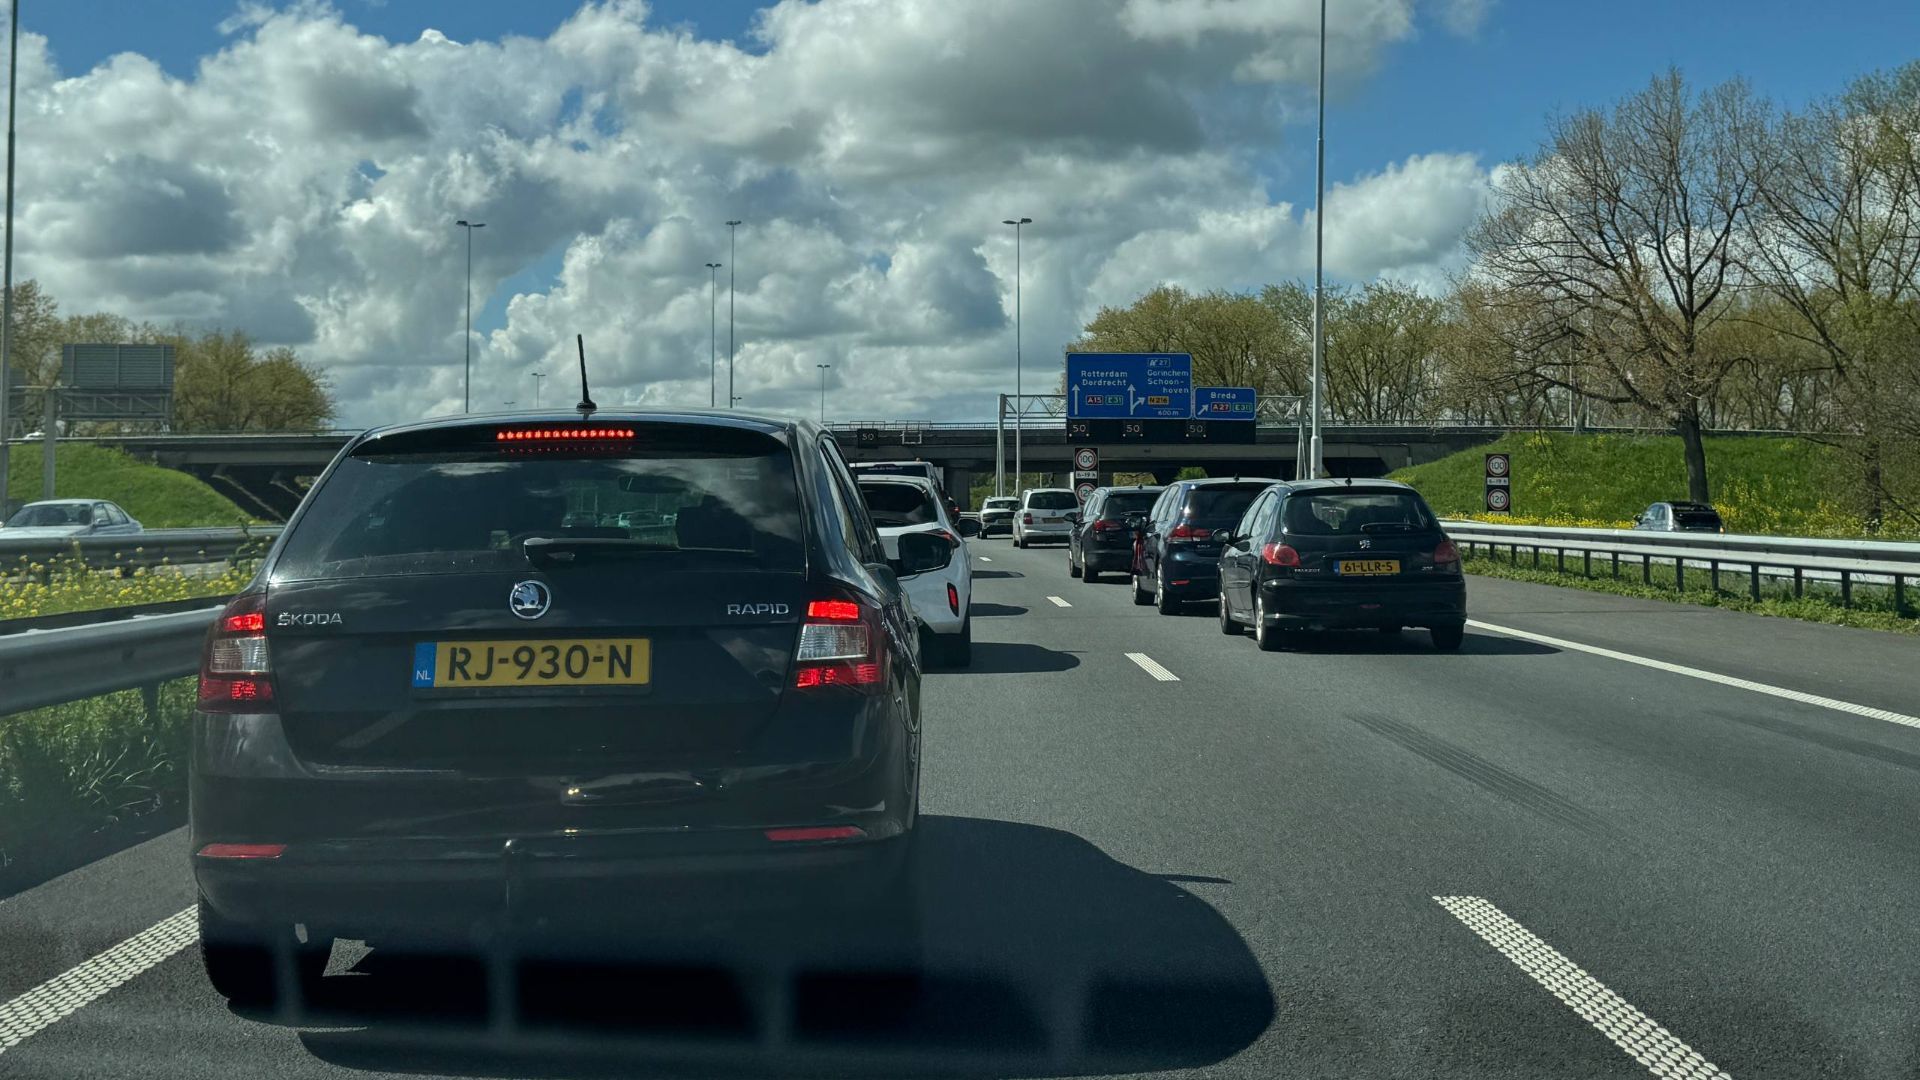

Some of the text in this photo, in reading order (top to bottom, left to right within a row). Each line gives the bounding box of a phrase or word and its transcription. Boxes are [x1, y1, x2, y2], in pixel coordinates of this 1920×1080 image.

[1081, 370, 1128, 378] Rotterdam
[1147, 369, 1189, 377] Gorinchem
[1147, 377, 1184, 385] Schoon-
[1072, 424, 1086, 433] 50
[1126, 424, 1140, 433] 50
[1189, 424, 1203, 433] 50
[1080, 454, 1094, 464] 100
[1491, 461, 1505, 470] 100
[1492, 495, 1506, 504] 120
[727, 602, 790, 616] RAPID
[277, 611, 343, 626] ŠKODA
[448, 643, 634, 682] RJ-930-N
[416, 669, 432, 681] NL
